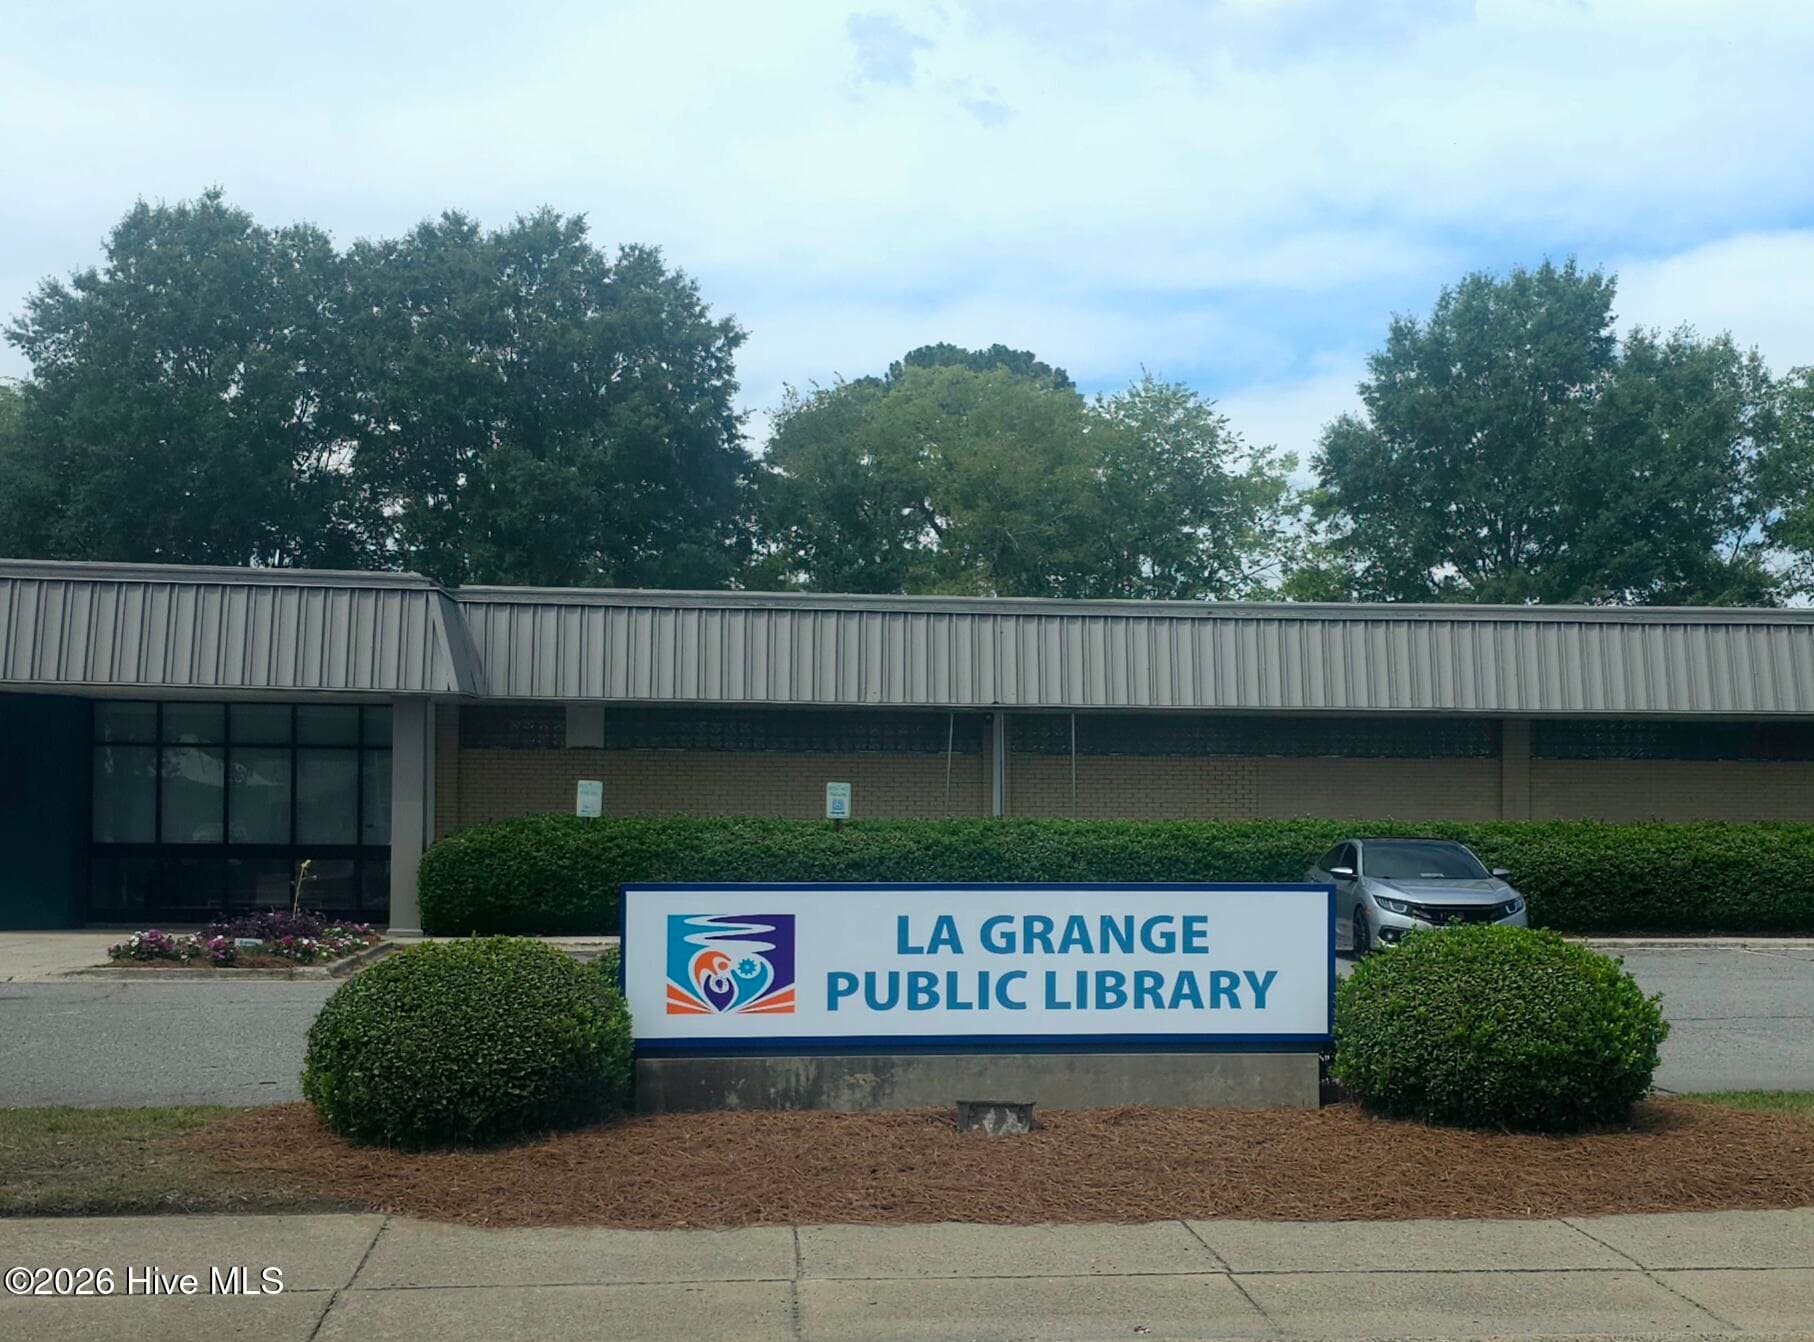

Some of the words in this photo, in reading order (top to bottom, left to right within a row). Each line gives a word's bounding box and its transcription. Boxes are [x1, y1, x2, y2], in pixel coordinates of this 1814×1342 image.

[896, 914, 965, 955] LA
[979, 914, 1210, 955] GRANGE
[826, 969, 1028, 1012] PUBLIC
[1044, 969, 1279, 1011] LIBRARY
